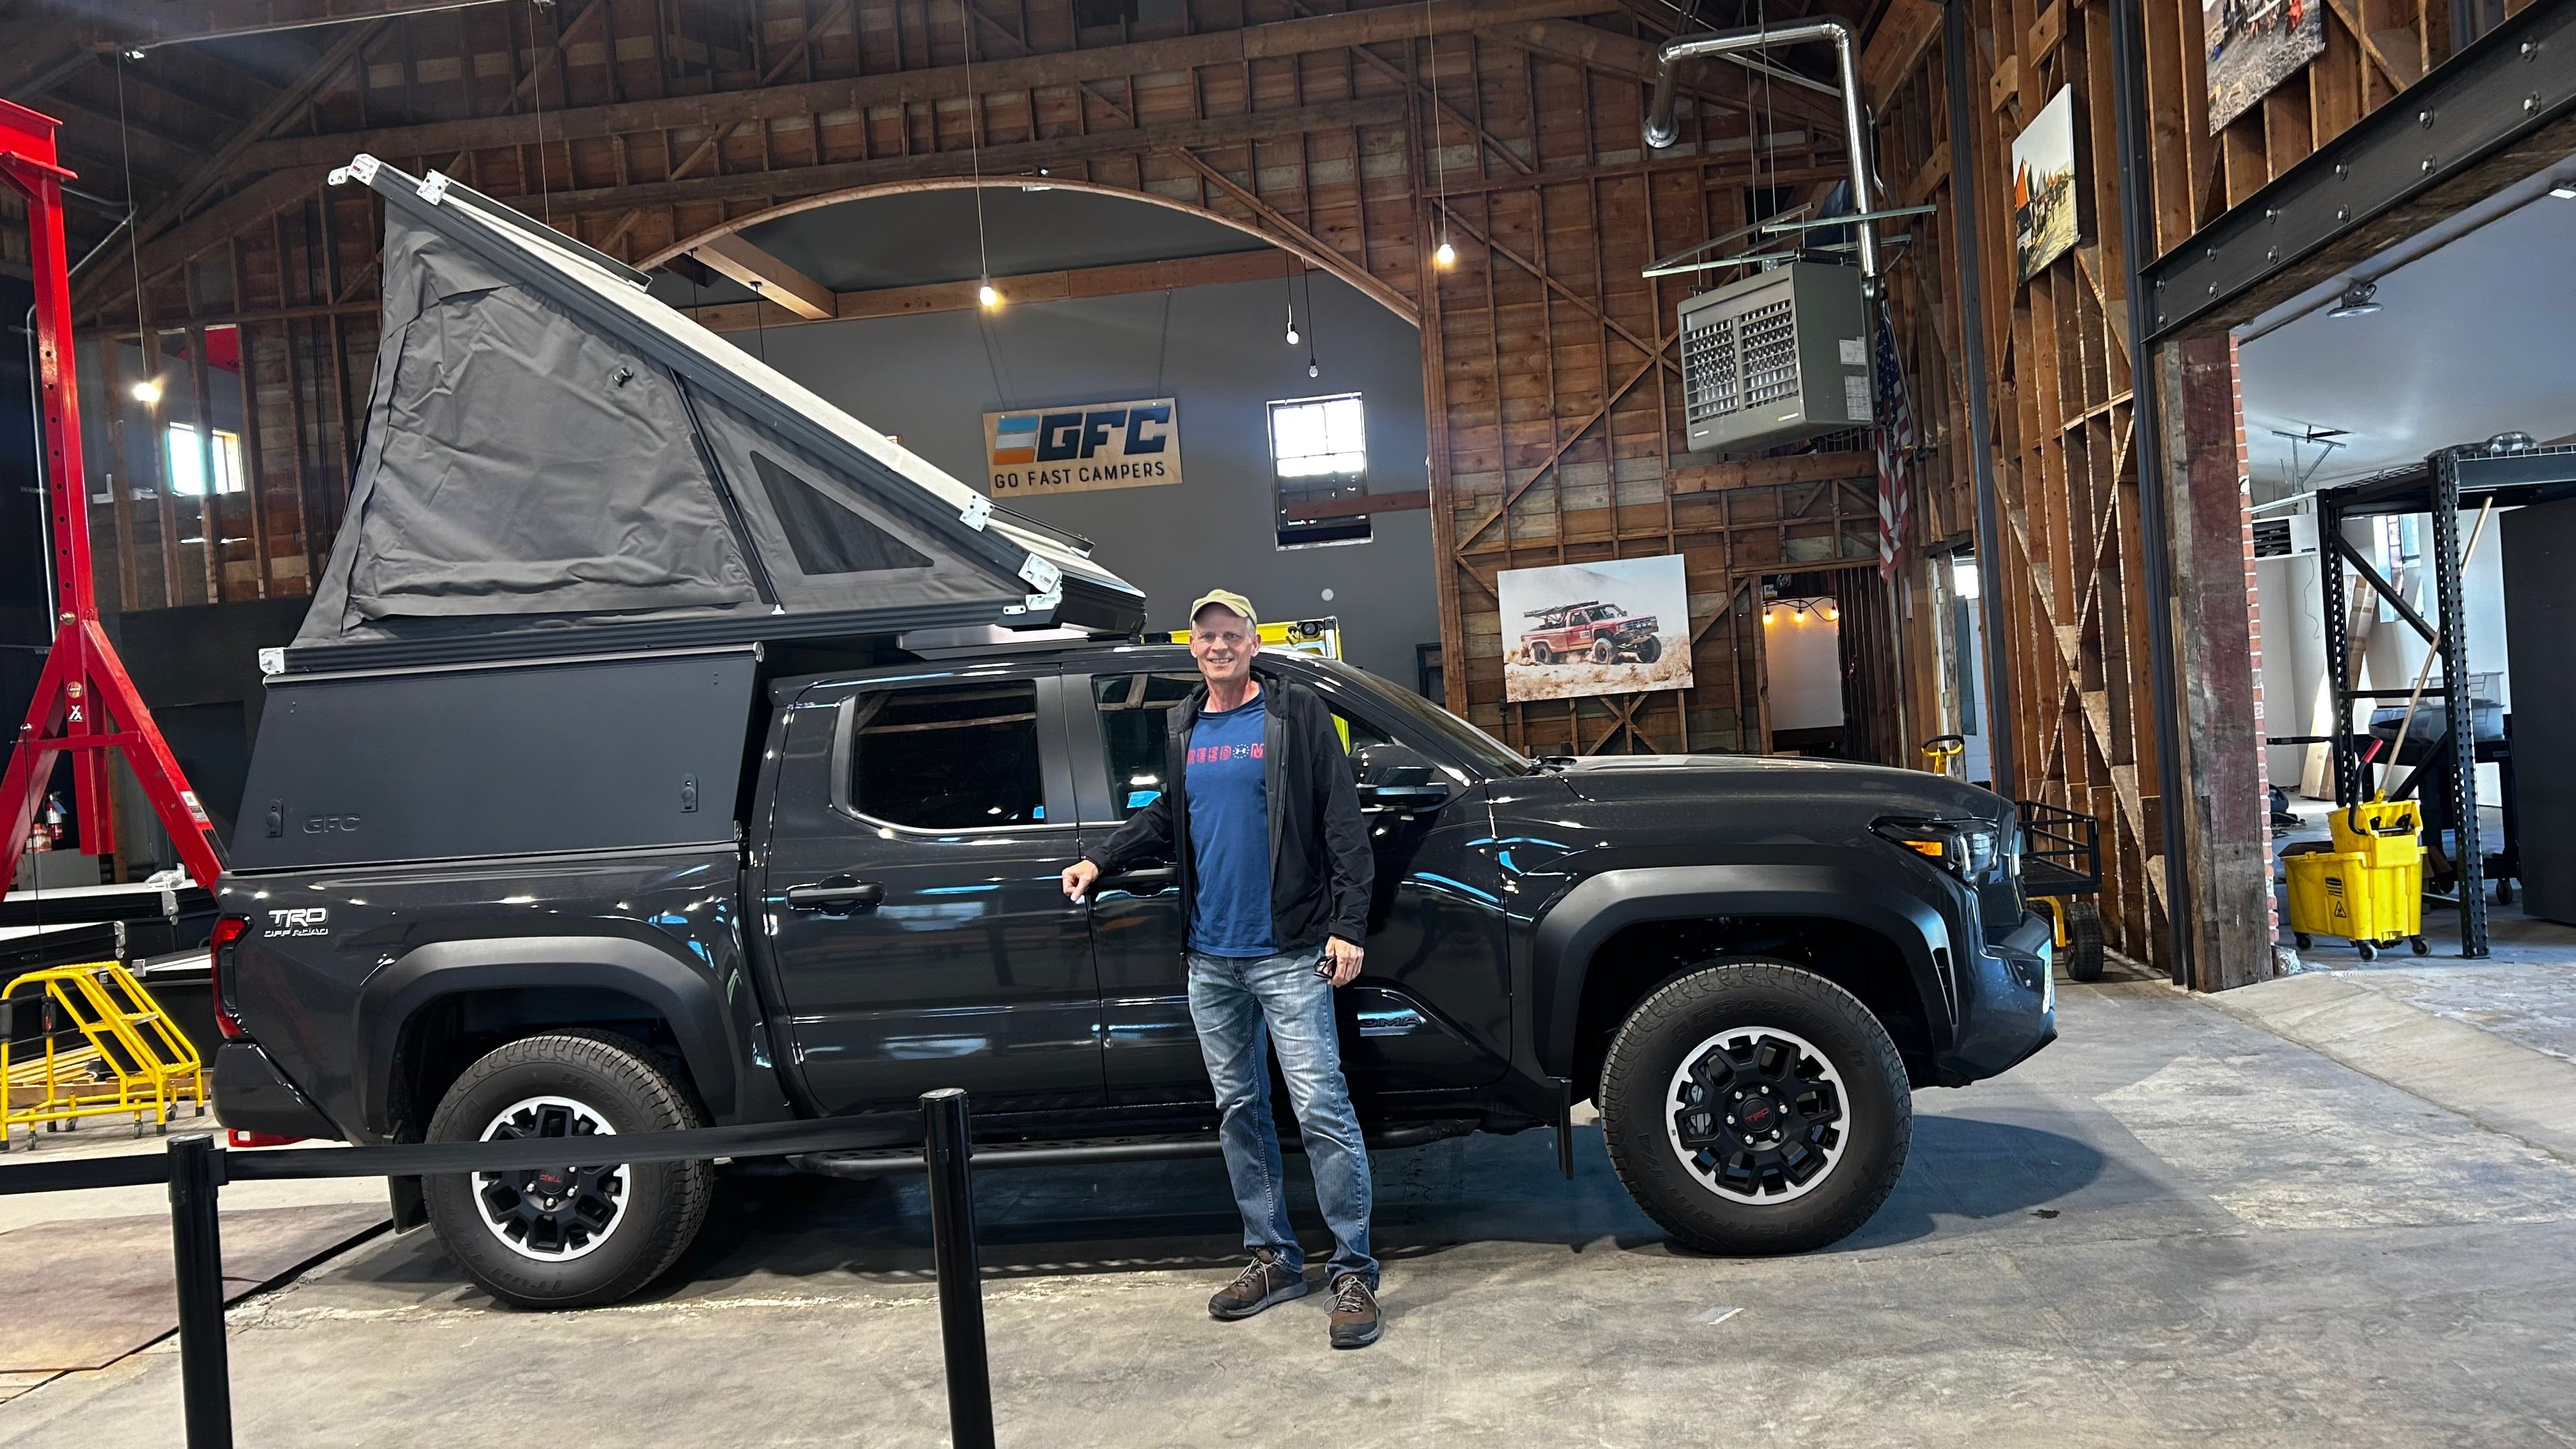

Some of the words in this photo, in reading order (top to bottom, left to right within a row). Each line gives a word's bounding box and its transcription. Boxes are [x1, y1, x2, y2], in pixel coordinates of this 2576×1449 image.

[1036, 405, 1171, 463] GFC
[994, 472, 1019, 489] GO
[1027, 468, 1071, 487] FAST
[1078, 461, 1165, 483] CAMPERS
[303, 813, 361, 833] GFC
[268, 907, 328, 928] TRD
[263, 930, 291, 938] OFF
[291, 928, 328, 937] ROAD
[1745, 1107, 1770, 1123] TRD
